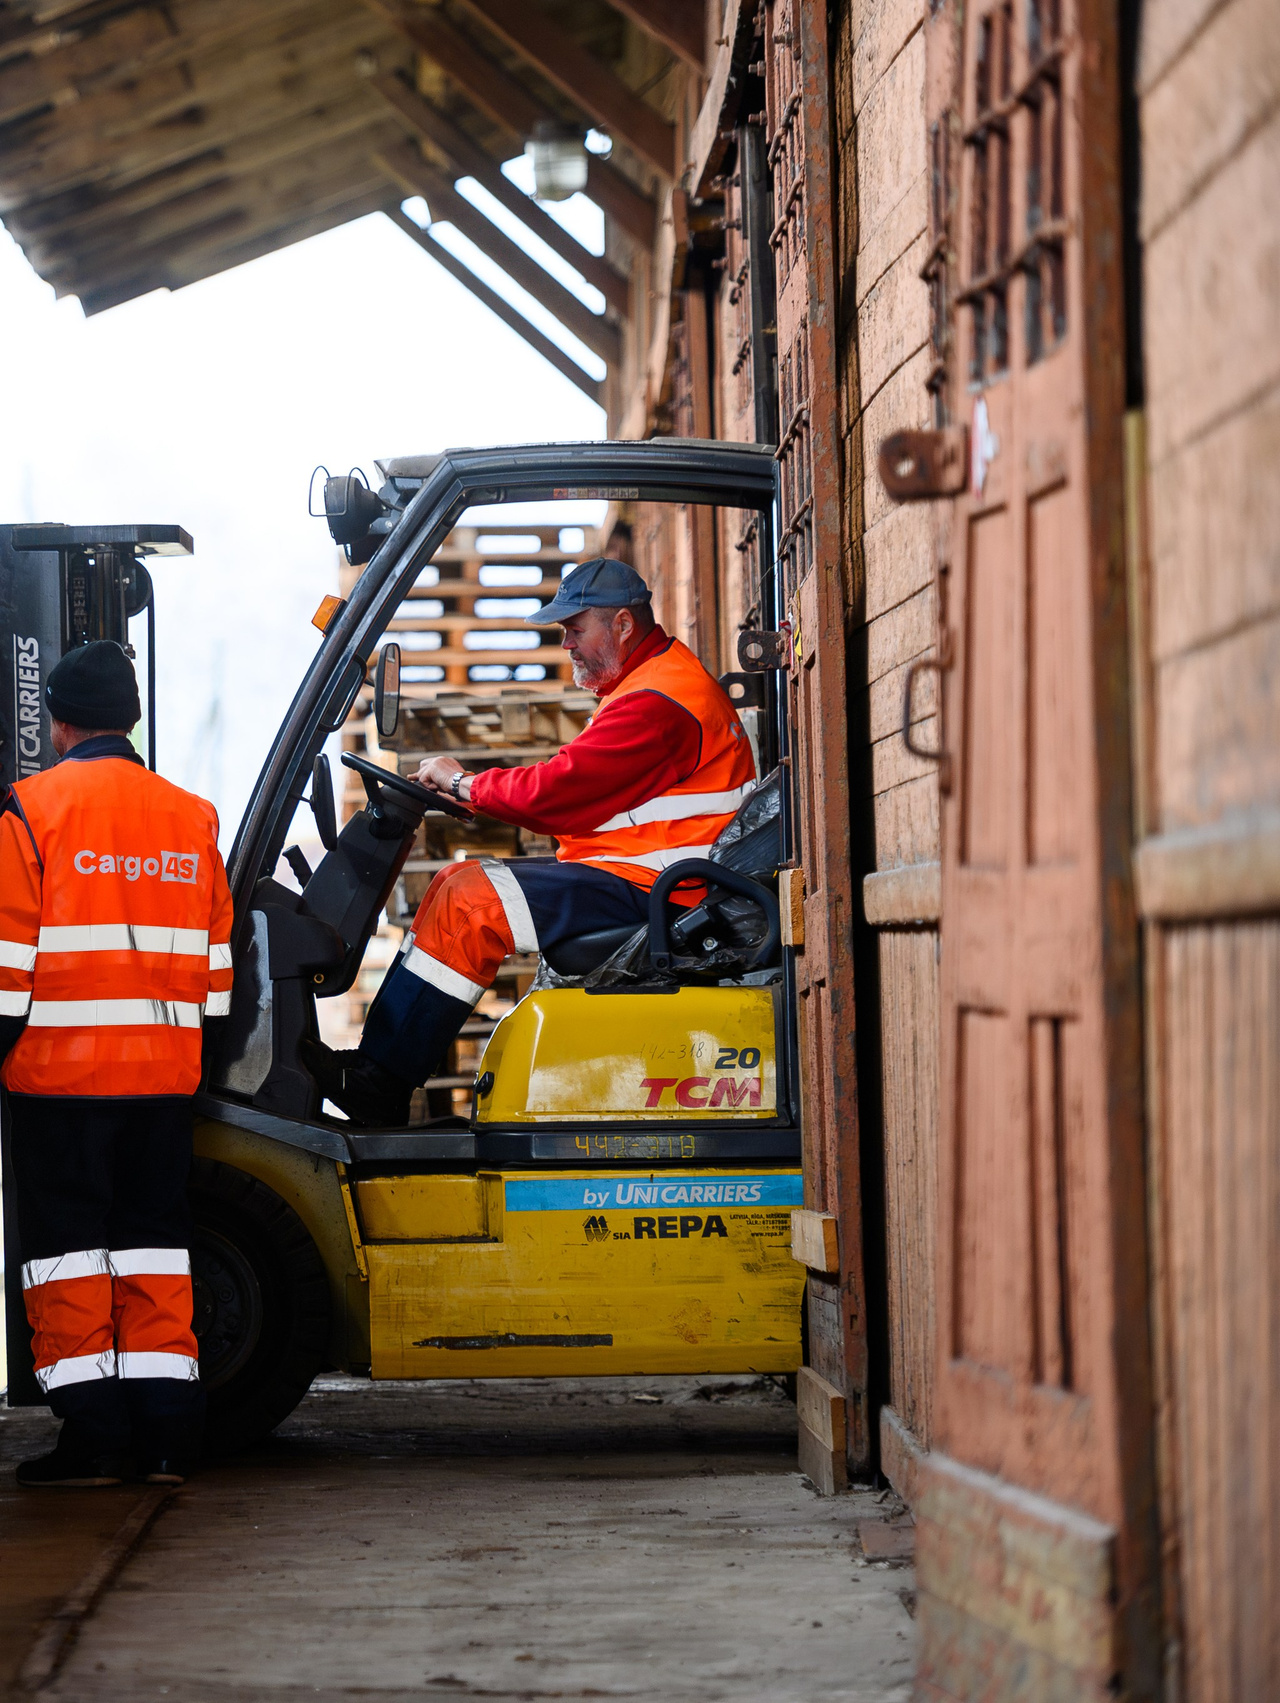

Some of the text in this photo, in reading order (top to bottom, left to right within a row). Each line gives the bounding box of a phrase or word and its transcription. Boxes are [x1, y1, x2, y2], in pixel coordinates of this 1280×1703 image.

[17, 635, 41, 777] ICARRIERS
[714, 1047, 761, 1070] 20
[639, 1076, 762, 1108] TCM
[575, 1134, 695, 1159] 442-318
[583, 1188, 610, 1208] by
[613, 1215, 729, 1240] SIA REPA
